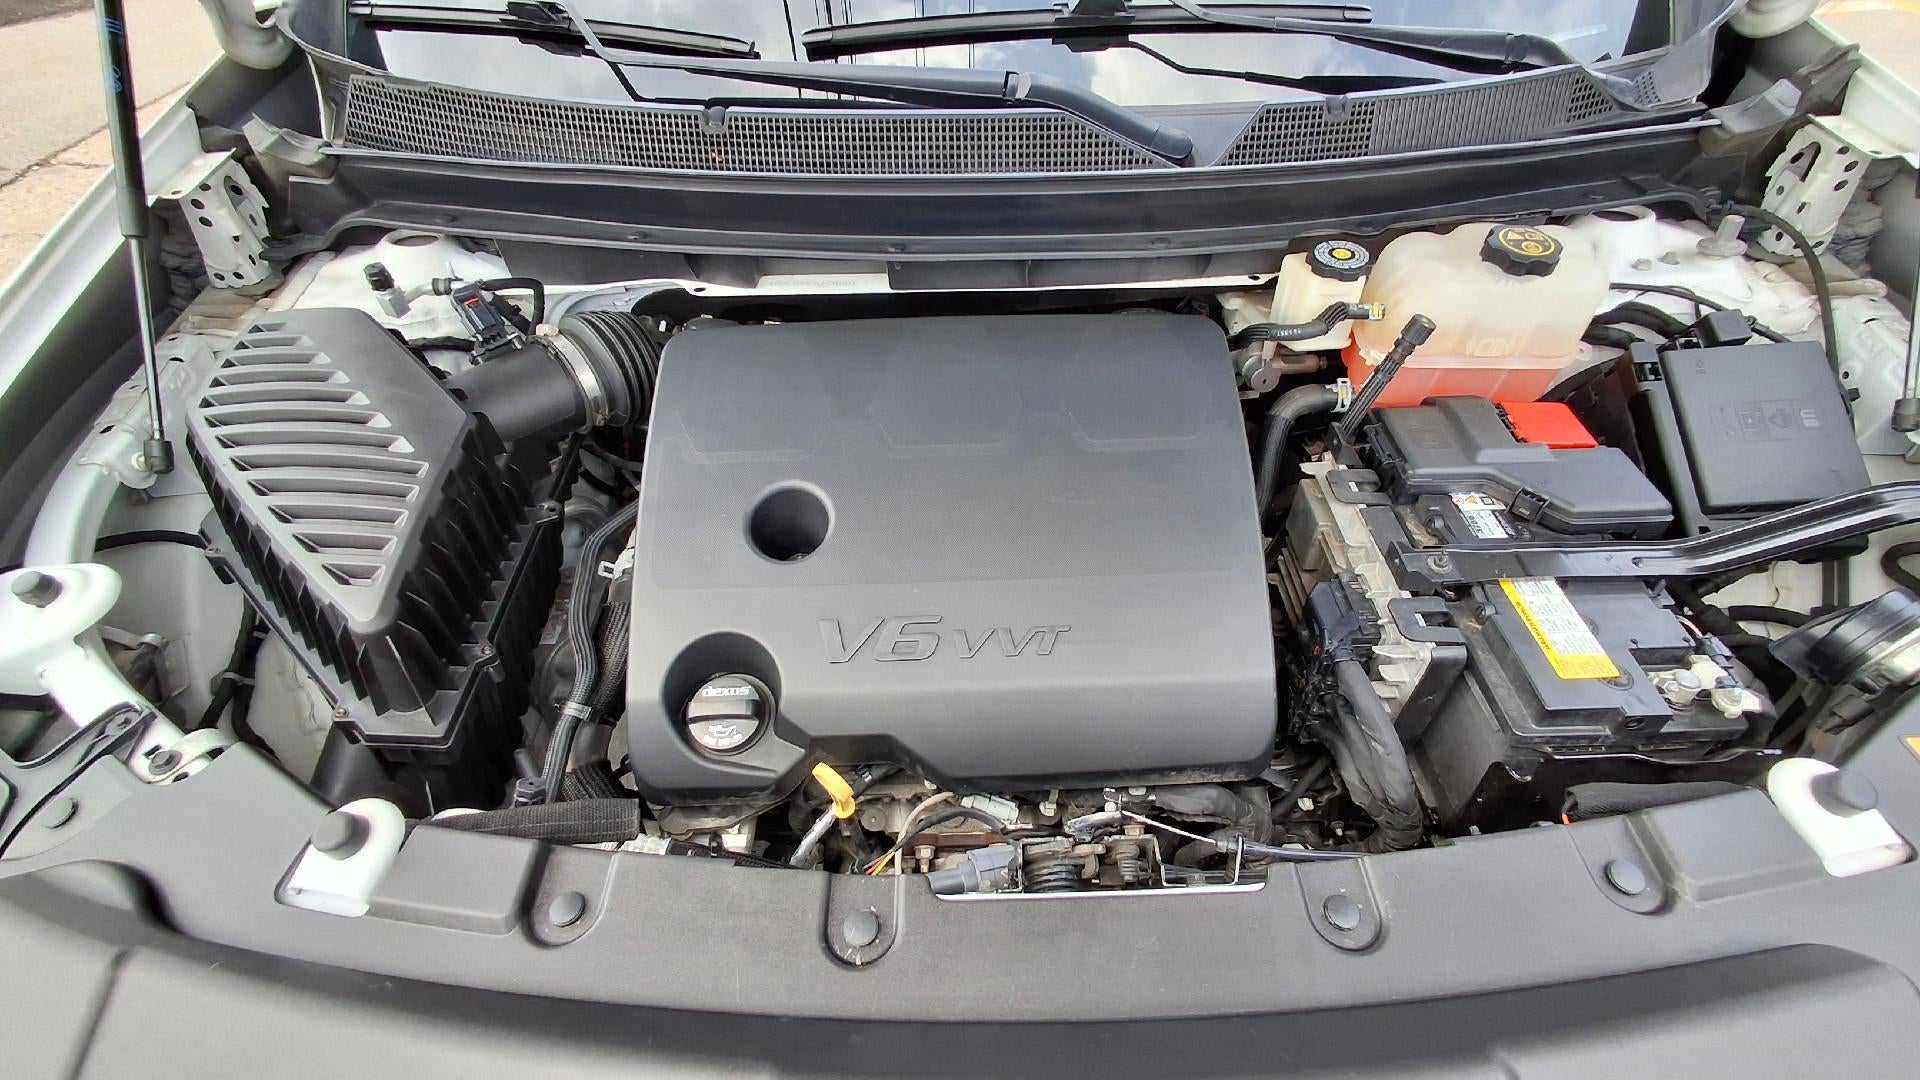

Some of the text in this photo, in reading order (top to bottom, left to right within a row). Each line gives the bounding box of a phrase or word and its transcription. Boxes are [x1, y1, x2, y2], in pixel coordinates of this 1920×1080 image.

[817, 615, 1072, 664] V6 VVT
[701, 685, 752, 697] dexos
